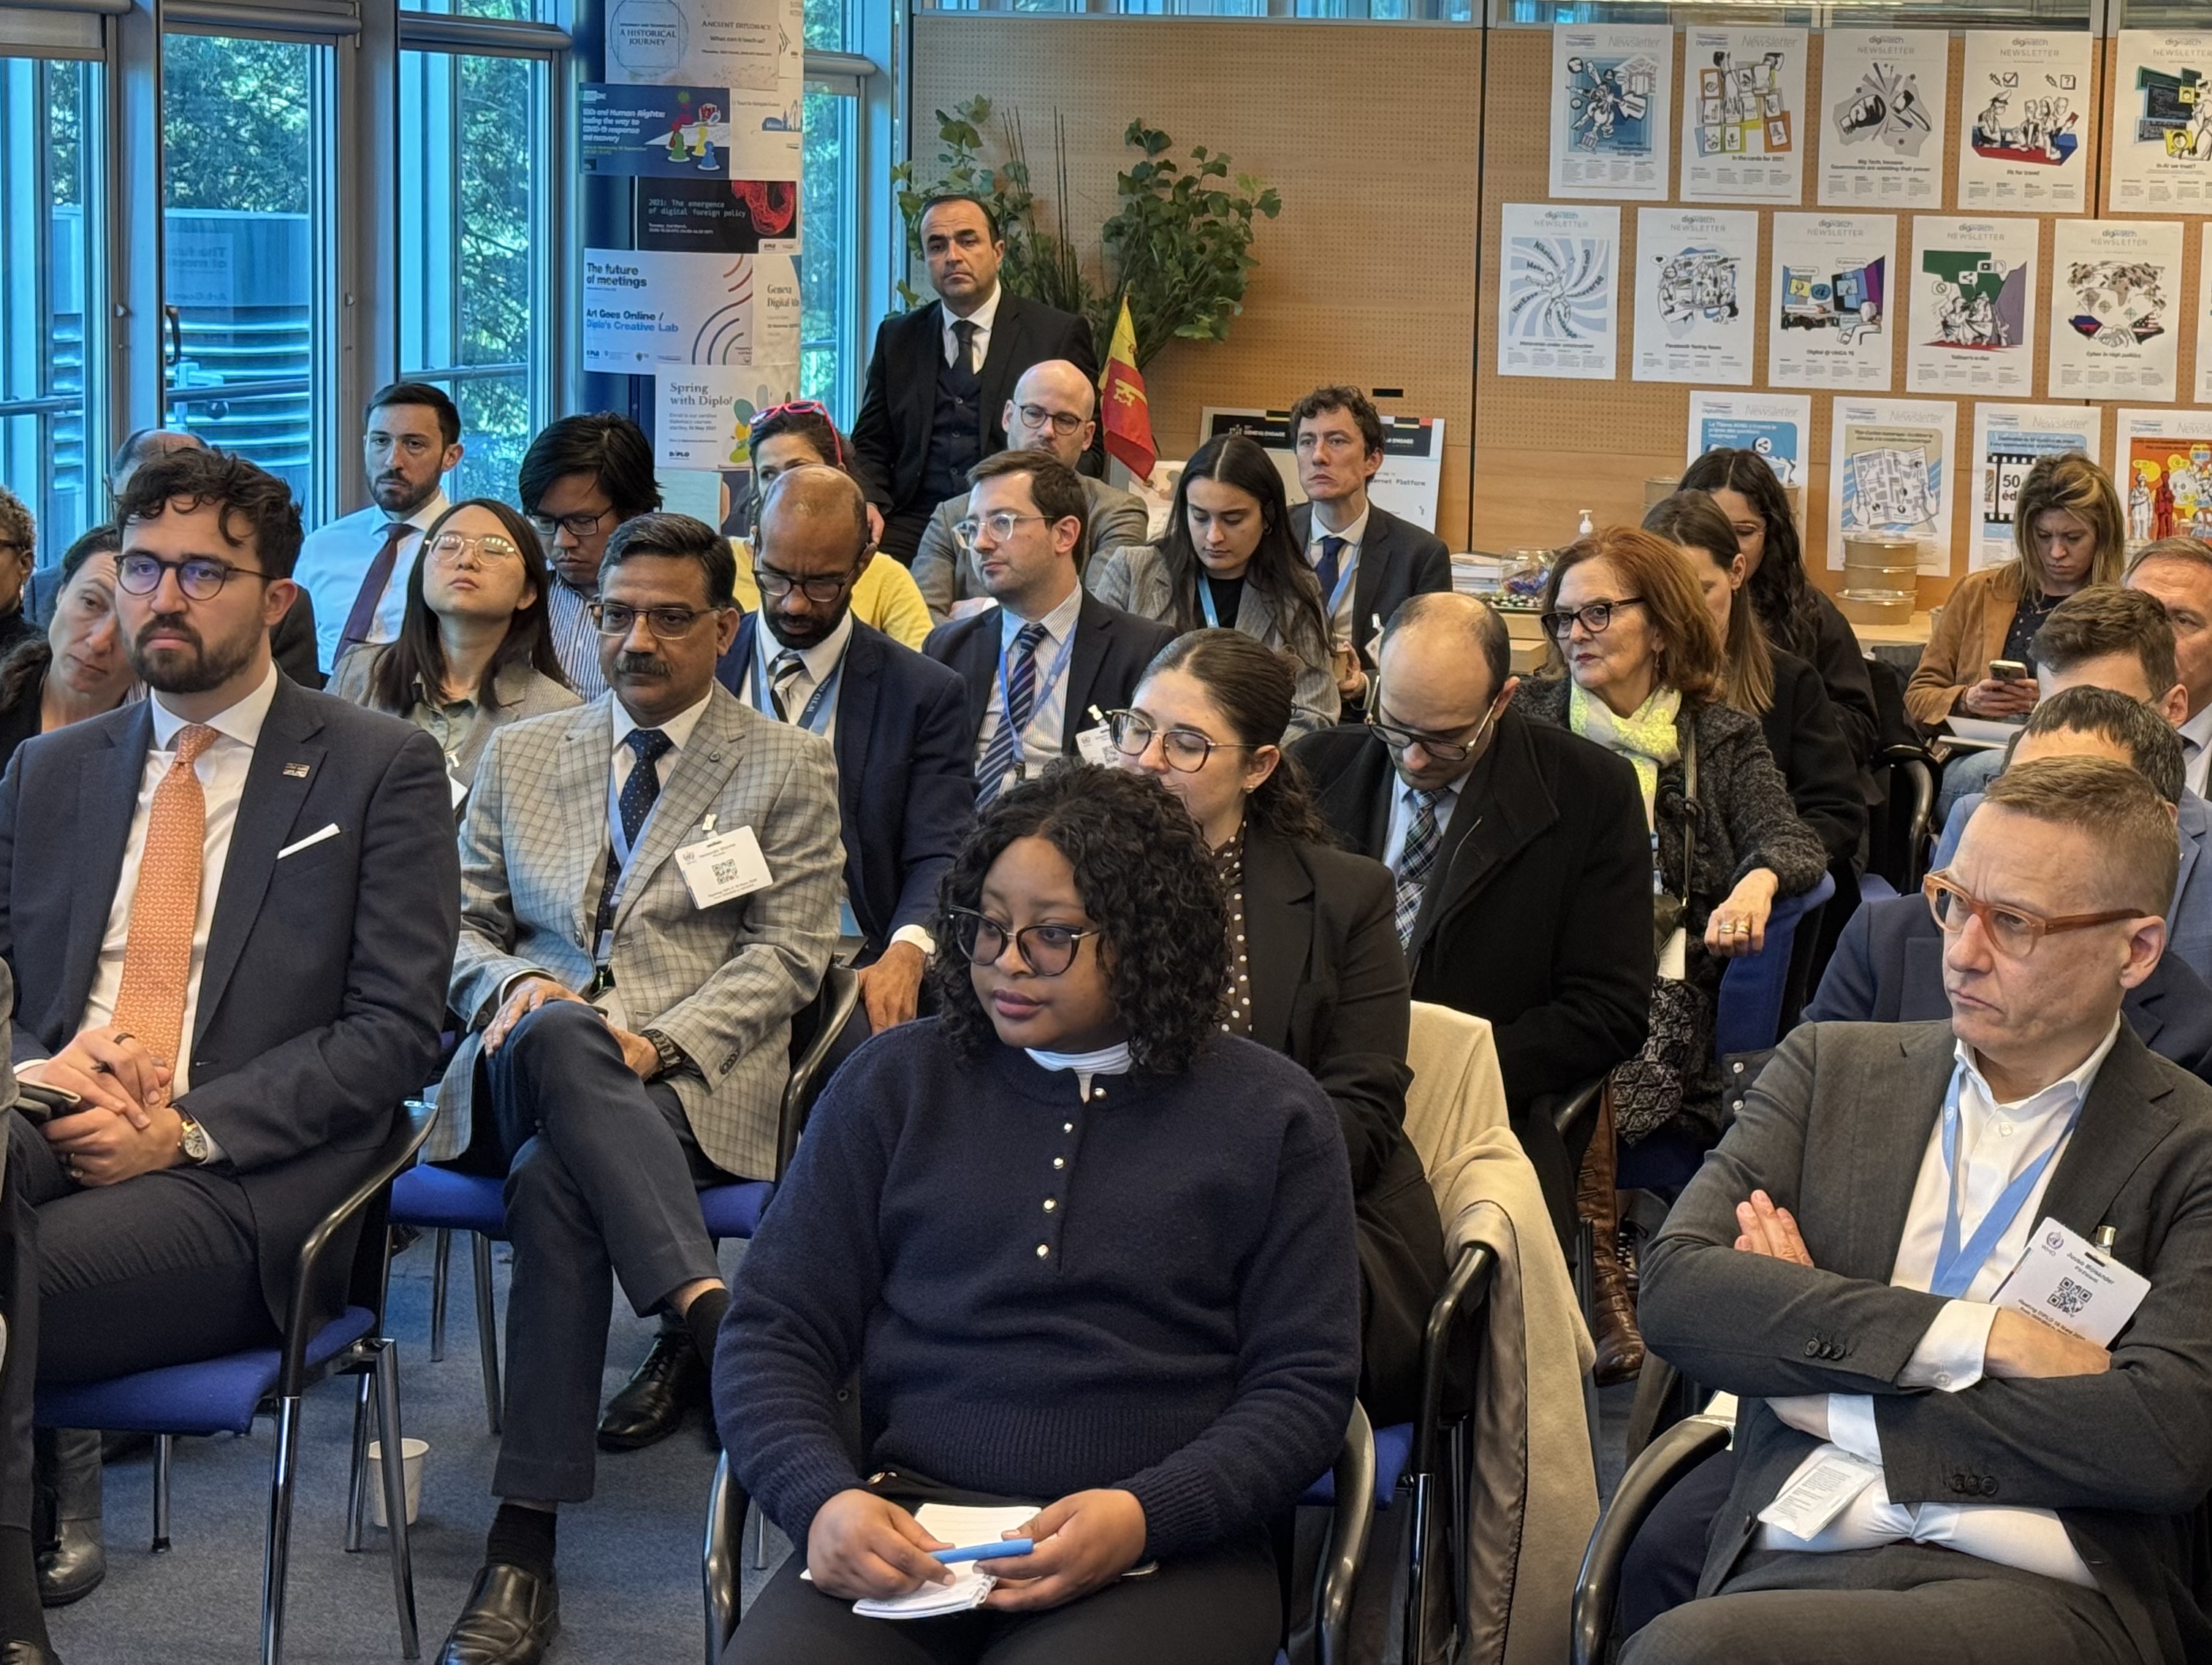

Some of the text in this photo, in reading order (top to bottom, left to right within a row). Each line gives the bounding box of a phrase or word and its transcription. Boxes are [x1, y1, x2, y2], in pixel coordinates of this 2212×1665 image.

[702, 20, 733, 28] ANCIENT
[628, 28, 677, 37] HISTORICAL
[629, 38, 666, 46] JOURNEY
[1608, 36, 1660, 47] Newsletter
[1741, 35, 1798, 47] Newsletter
[1857, 46, 1915, 54] NEWSLETTER
[2000, 49, 2059, 57] NEWSLETTER
[593, 135, 620, 143] recovery
[672, 199, 684, 207] The
[661, 207, 688, 216] digital
[693, 209, 720, 218] foreign
[723, 210, 745, 218] policy
[1534, 220, 1589, 228] NEWSLETTER
[1671, 224, 1725, 232] NEWSLETTER
[1807, 229, 1863, 237] NEWSLETTER
[1947, 232, 2004, 240] NEWSLETTER
[2091, 238, 2148, 246] NEWSLETTER
[587, 262, 639, 275] The future
[587, 274, 647, 289] of meetings
[587, 308, 598, 317] Art
[599, 309, 621, 319] Goes
[623, 310, 656, 321] Online
[587, 319, 679, 332] Diplo's Creative Lab
[669, 382, 709, 395] Spring
[669, 396, 733, 408] with Diplo!
[1745, 405, 1798, 416] Newsletter
[1890, 411, 1944, 423] Newsletter
[2032, 416, 2088, 429] Newsletter
[2002, 475, 2021, 488] 50
